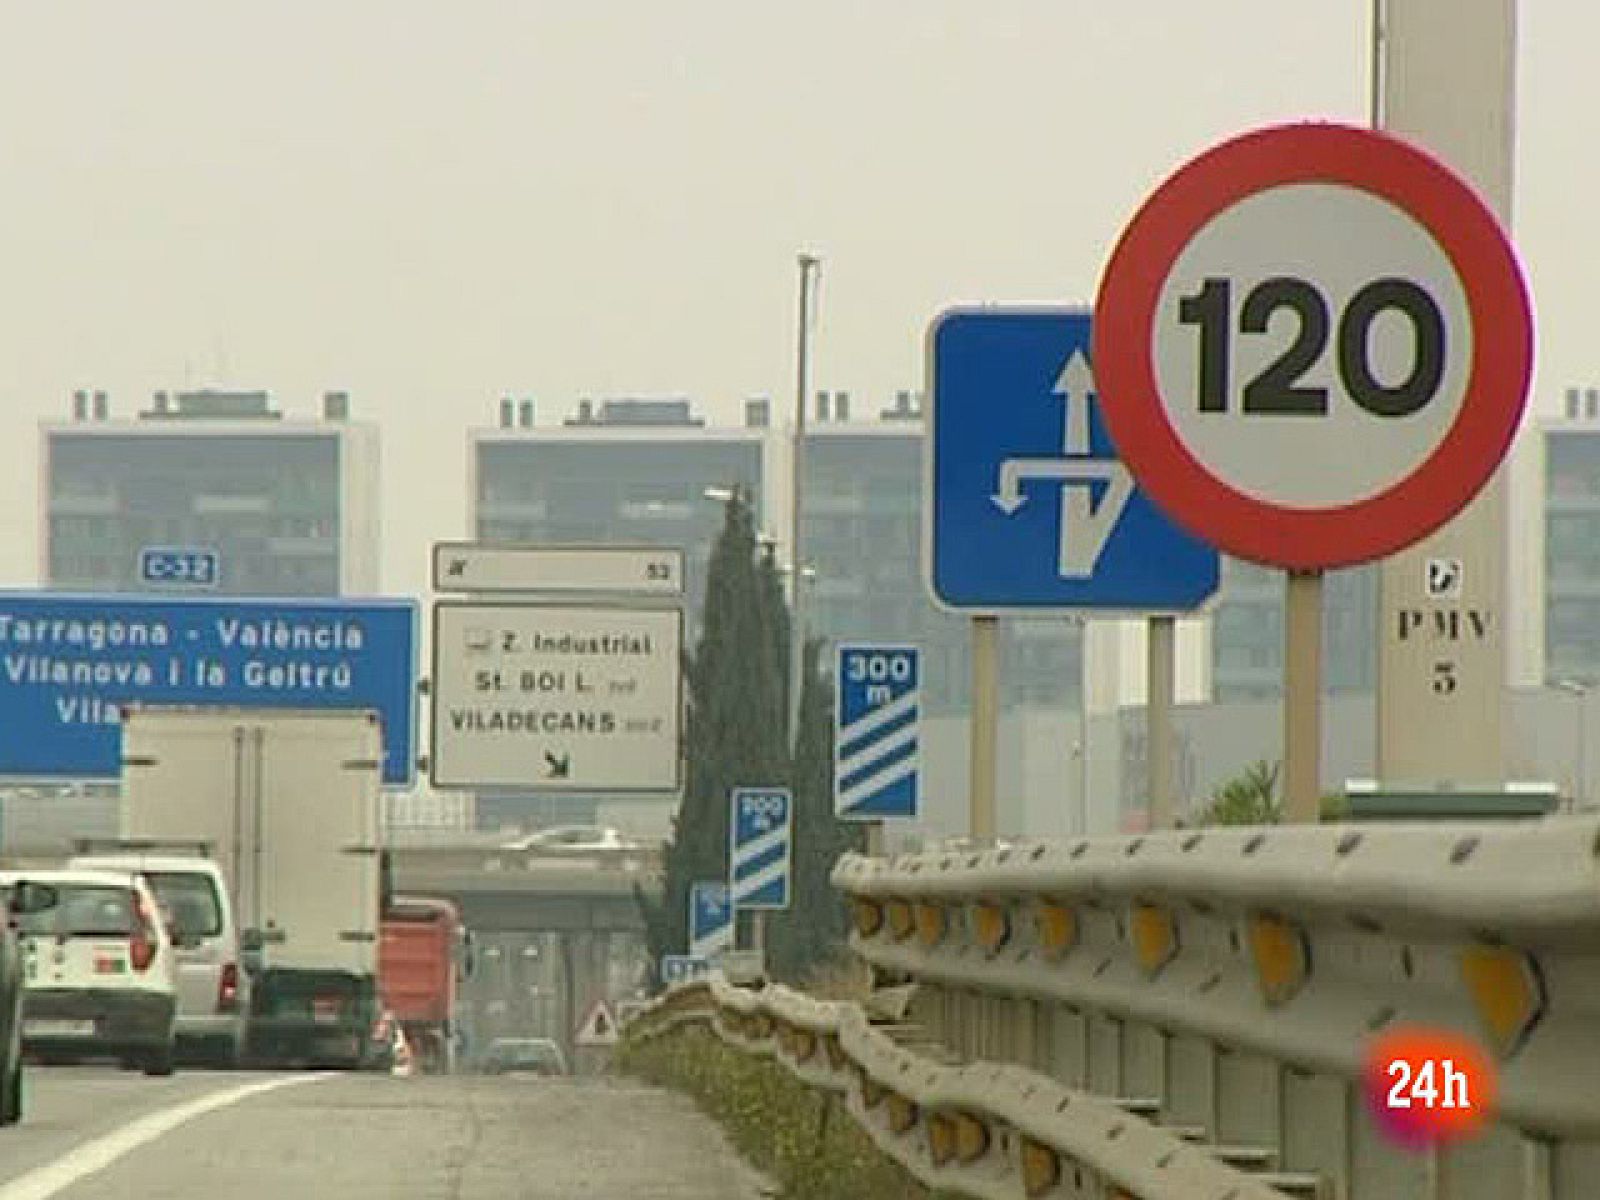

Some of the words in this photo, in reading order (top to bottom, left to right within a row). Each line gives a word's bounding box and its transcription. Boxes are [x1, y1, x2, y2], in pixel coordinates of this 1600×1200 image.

[1179, 276, 1446, 417] 120
[0, 614, 168, 650] Tarragona
[216, 614, 364, 650] València
[534, 631, 652, 655] Industrial
[4, 654, 153, 686] Vilanova
[196, 657, 225, 687] la
[243, 657, 351, 690] Geltrú
[848, 656, 911, 681] 300
[1433, 663, 1457, 694] 5
[520, 671, 566, 692] BOI
[866, 684, 891, 703] m
[451, 709, 616, 734] VILADECANS
